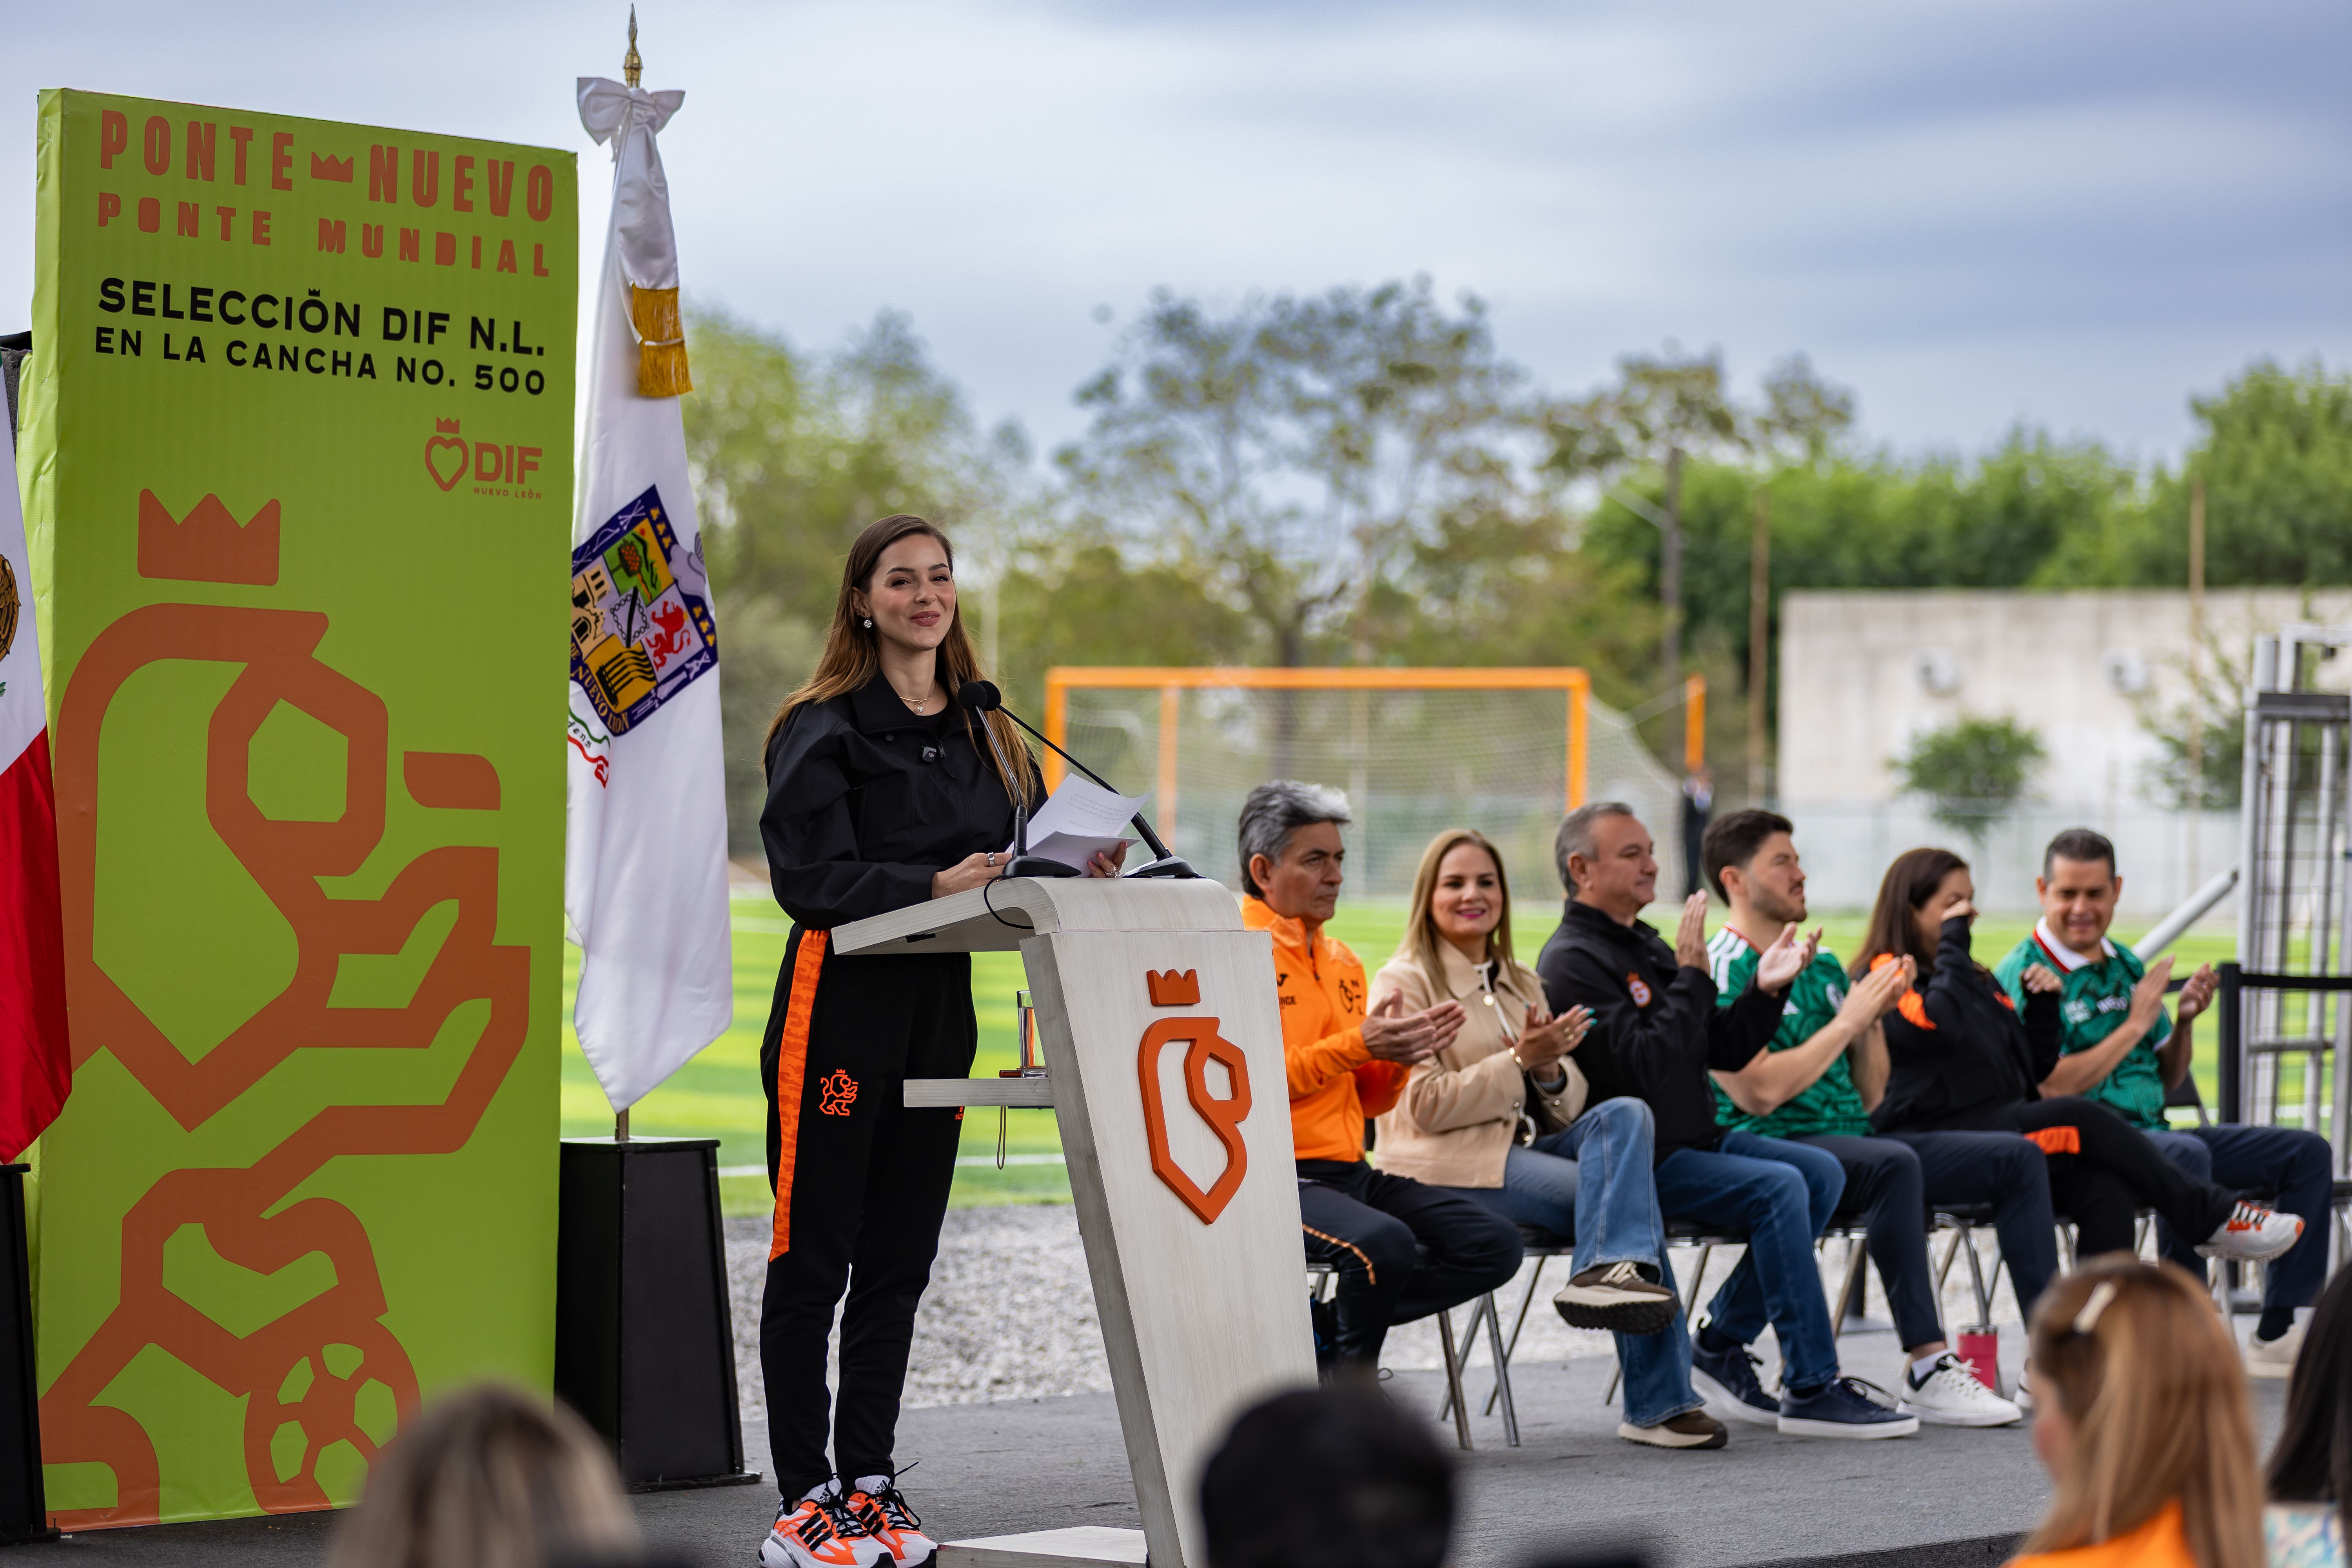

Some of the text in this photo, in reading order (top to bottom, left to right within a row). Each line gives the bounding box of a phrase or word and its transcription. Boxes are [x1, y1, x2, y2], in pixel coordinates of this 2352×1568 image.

[100, 109, 553, 222] PONTE NUEVO
[98, 192, 549, 278] PONTE MUNDIAL
[383, 307, 450, 345] DIF
[470, 316, 544, 356] N.L.
[95, 326, 544, 395] EN LA CANCHA NO. 500
[474, 442, 543, 485] DIF
[474, 487, 509, 497] NUEVO
[571, 666, 608, 717] NUEVO
